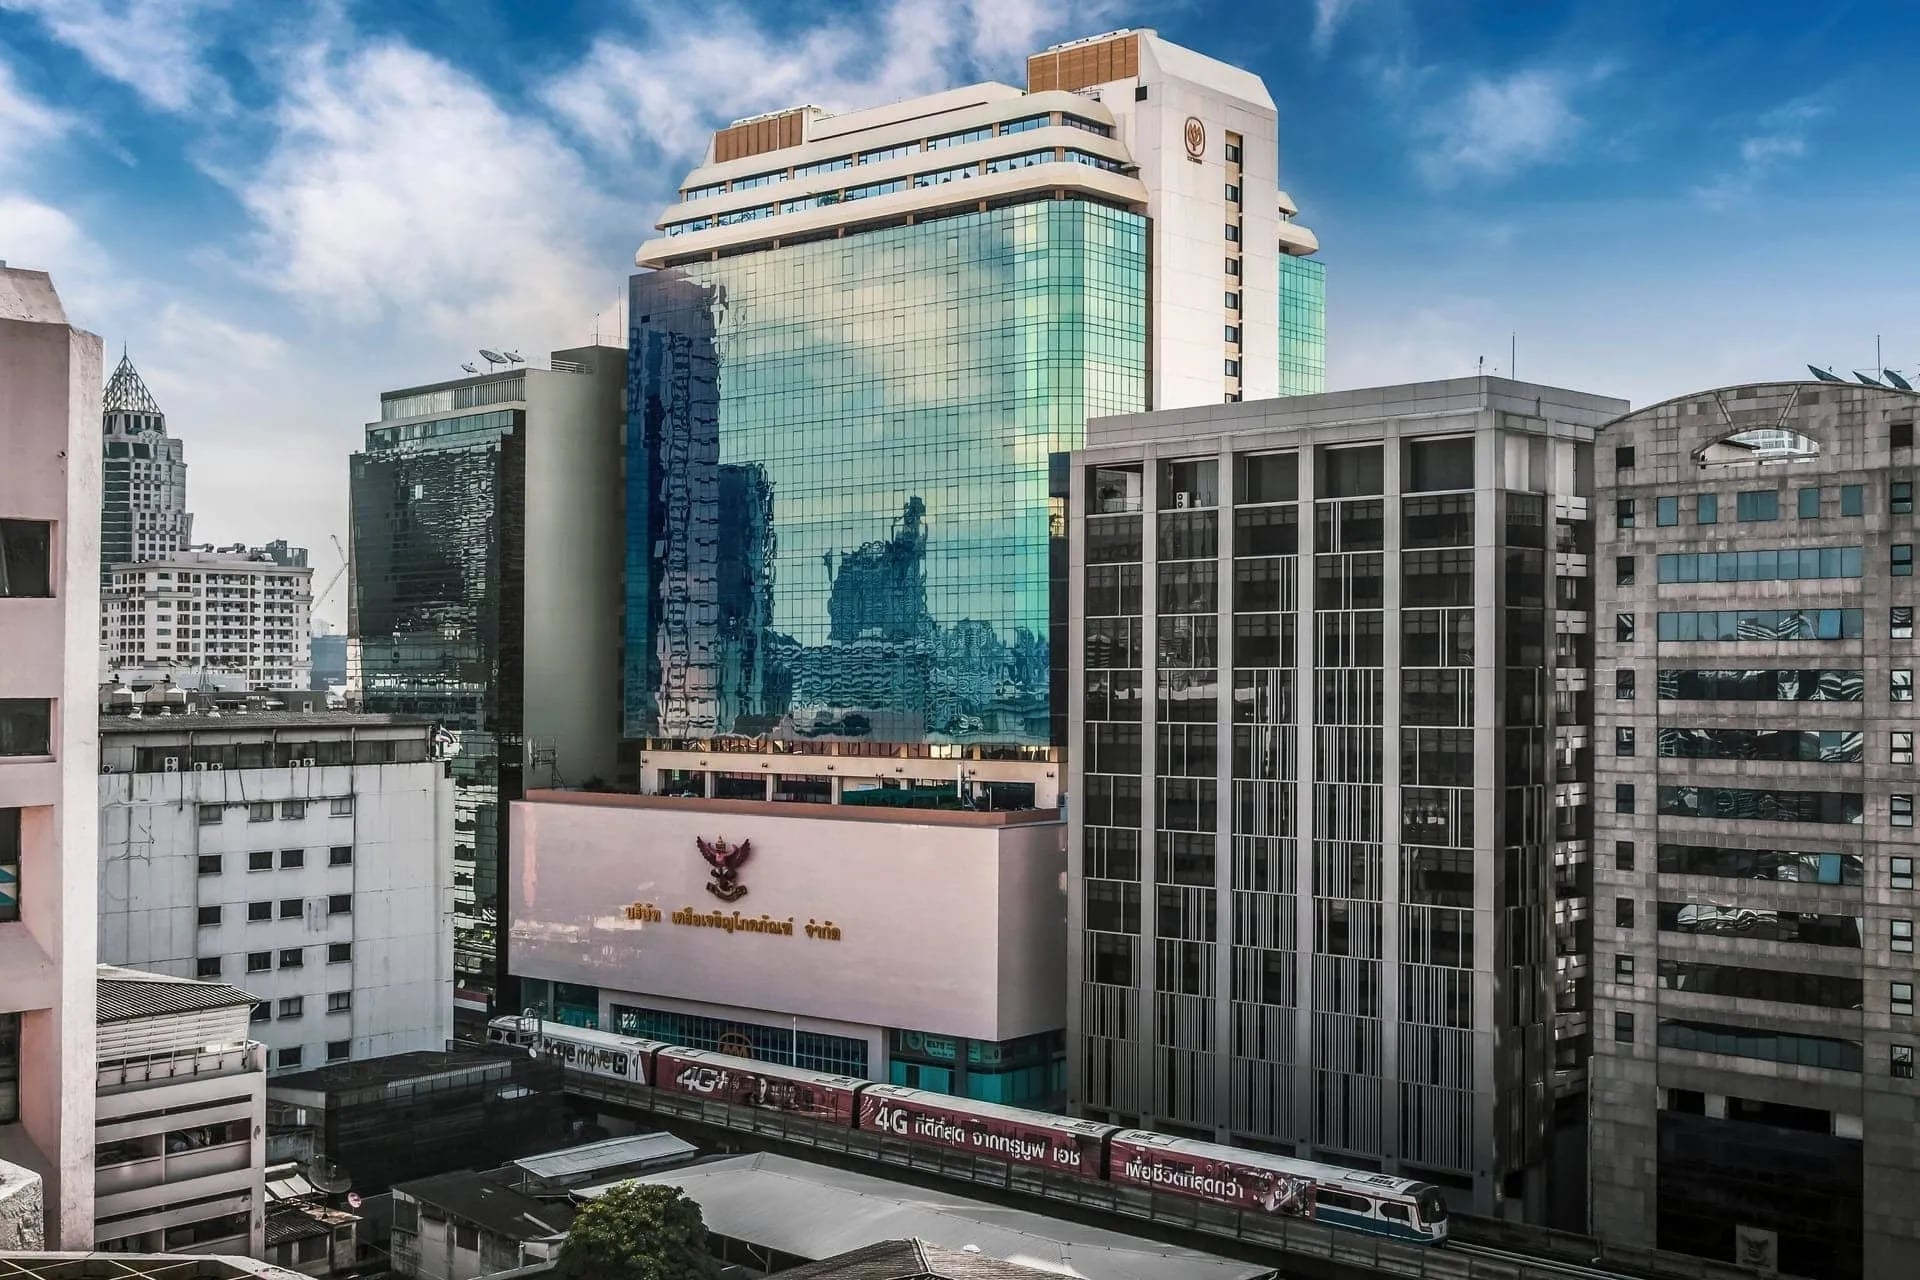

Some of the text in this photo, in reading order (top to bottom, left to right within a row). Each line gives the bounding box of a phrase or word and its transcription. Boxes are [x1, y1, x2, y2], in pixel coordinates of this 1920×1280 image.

[625, 903, 662, 922] บริษัท
[804, 918, 841, 941] จำกัด
[577, 1047, 613, 1069] move
[875, 1106, 1081, 1166] 4G ที่ดีที่สุด จากทรูมูฟ เอช
